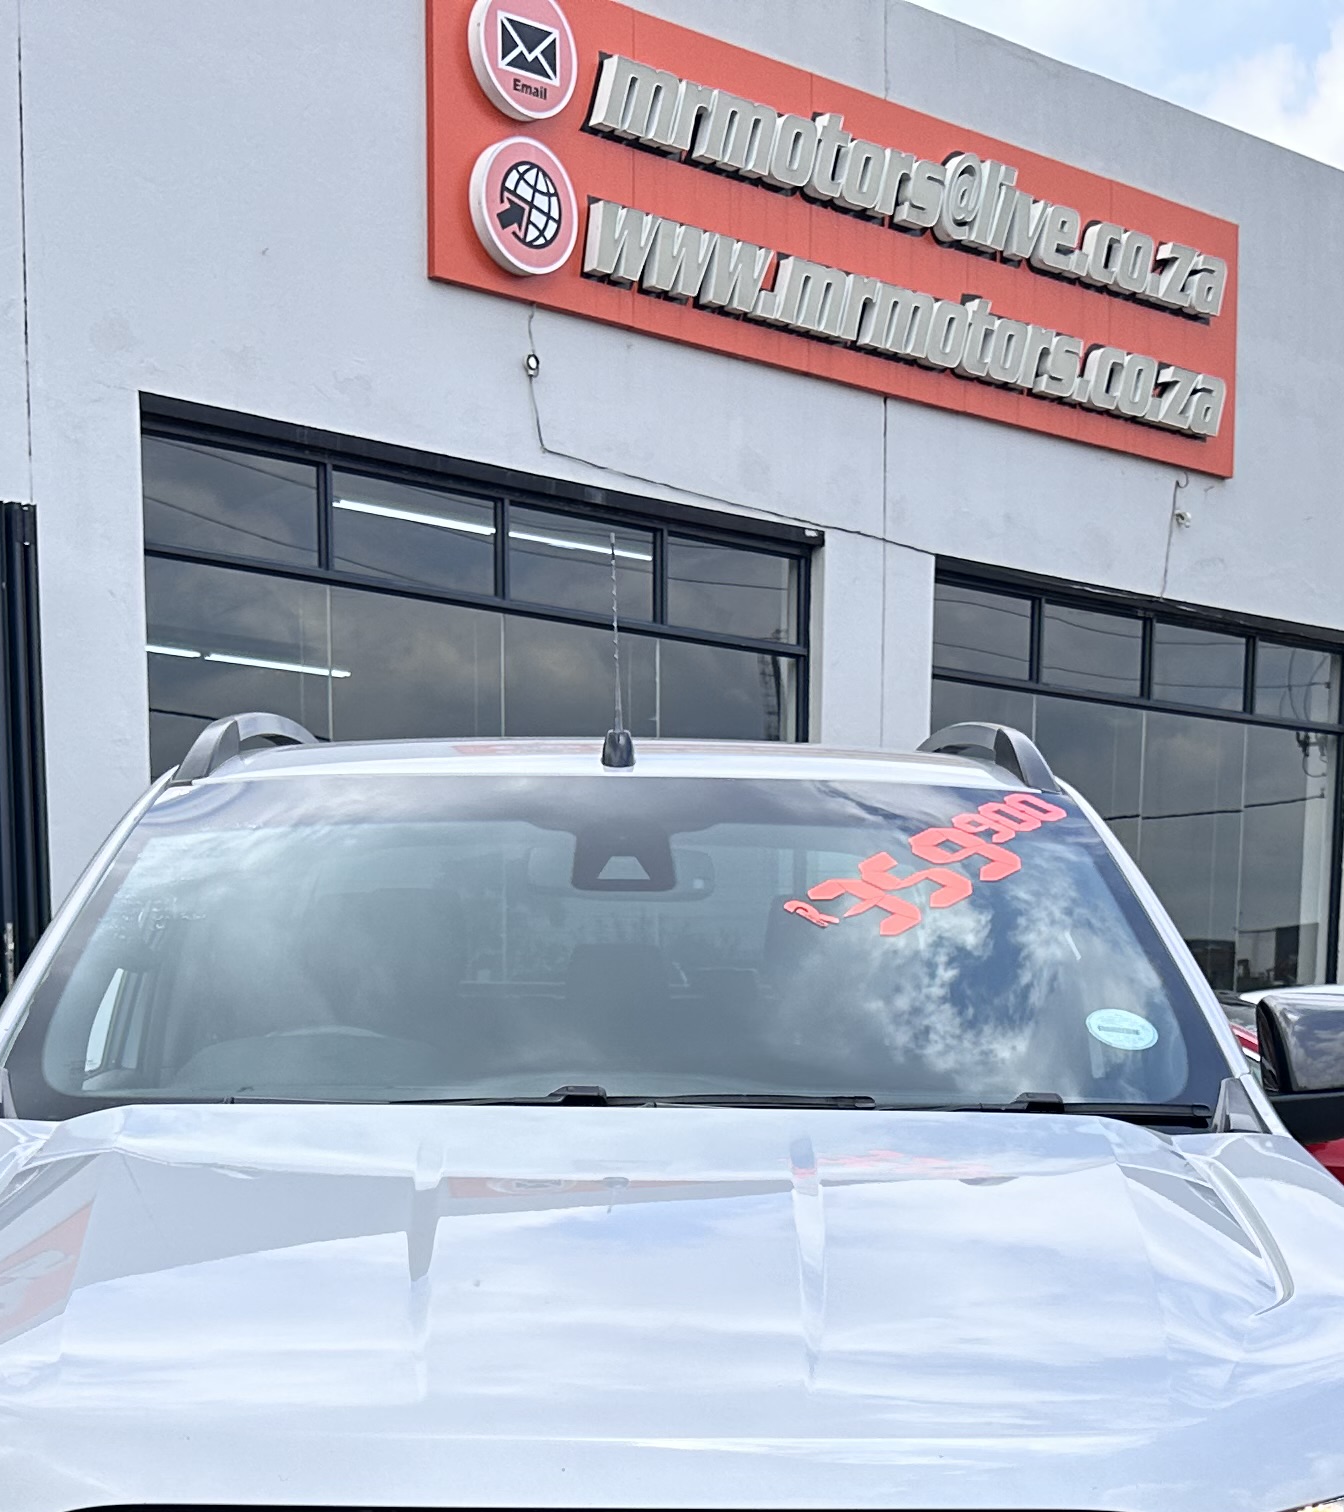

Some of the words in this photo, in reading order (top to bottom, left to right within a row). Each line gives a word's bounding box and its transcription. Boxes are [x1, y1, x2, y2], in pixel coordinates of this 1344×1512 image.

[512, 77, 548, 101] Email
[590, 54, 1227, 317] mrmotors@live.co.za
[584, 200, 1226, 437] www.mrmotors.co.za
